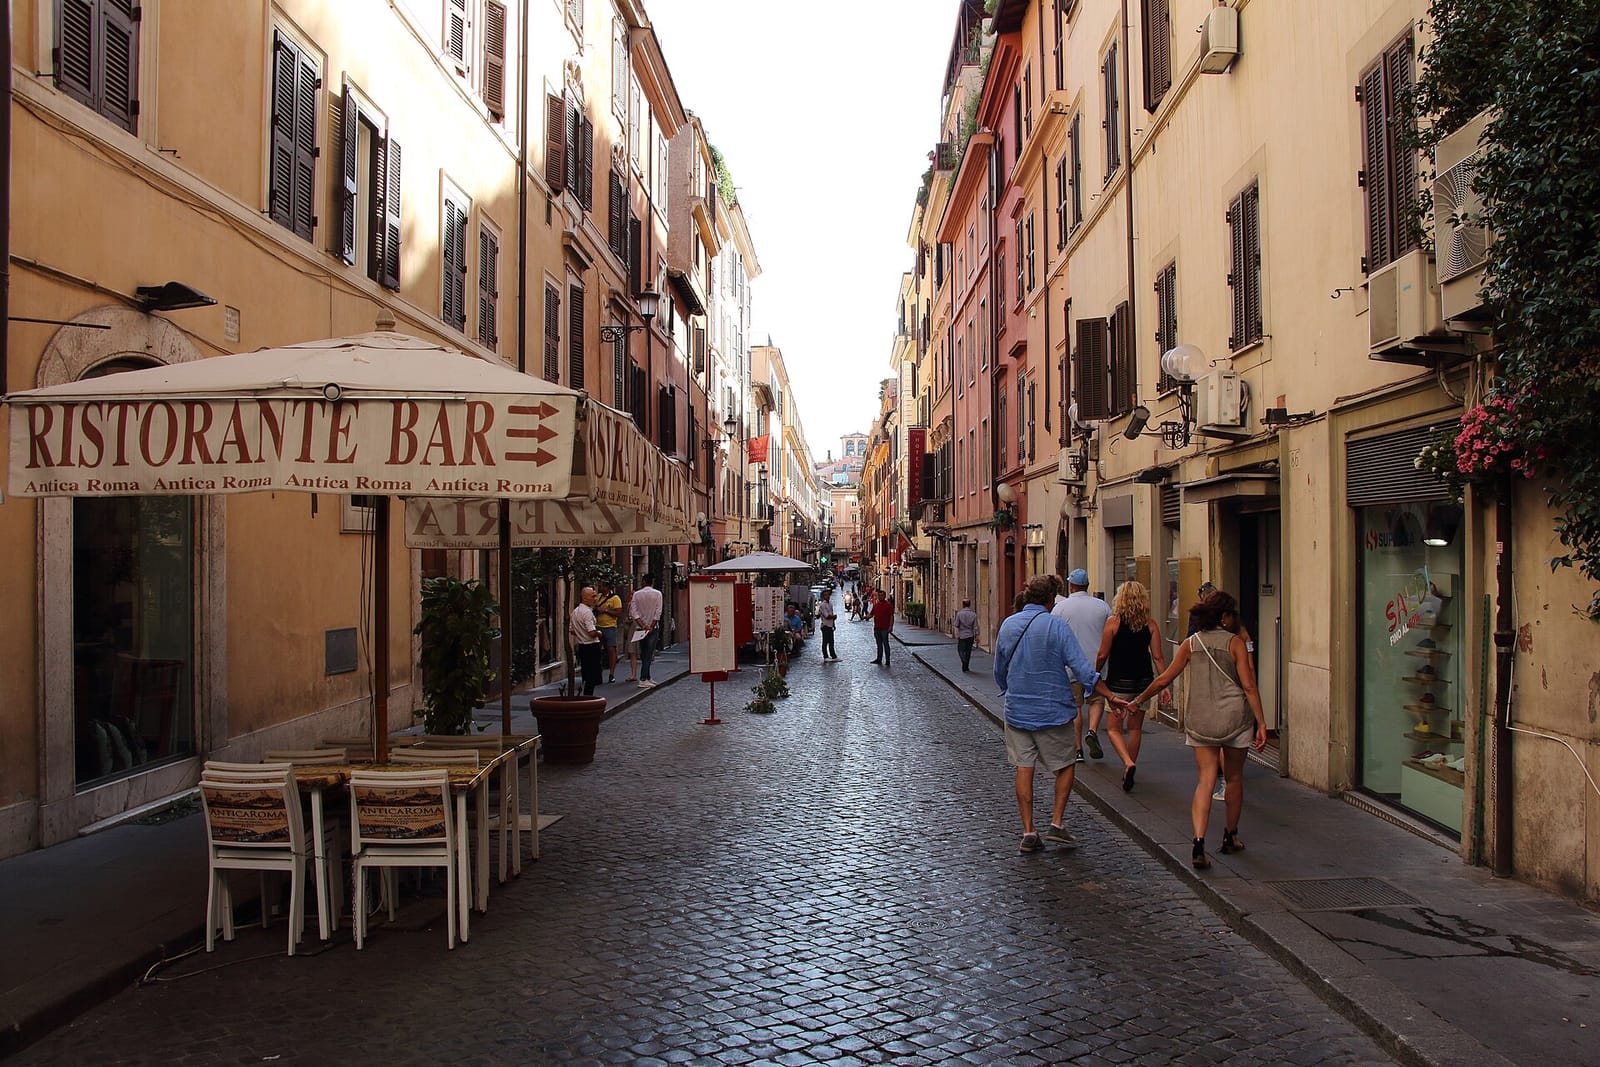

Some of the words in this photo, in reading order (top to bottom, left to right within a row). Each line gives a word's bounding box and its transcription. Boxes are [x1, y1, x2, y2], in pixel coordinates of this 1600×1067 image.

[25, 399, 360, 468] RISTORANTE
[384, 400, 497, 467] BAR
[24, 478, 79, 493] Antica
[87, 479, 140, 491] Roma
[153, 476, 216, 490] Antica
[222, 476, 272, 488] Roma
[285, 473, 349, 489] Antica
[355, 476, 412, 490] Roma
[426, 477, 489, 492] Antica
[496, 478, 553, 493] Roma
[360, 807, 442, 815] ANTICAROMA
